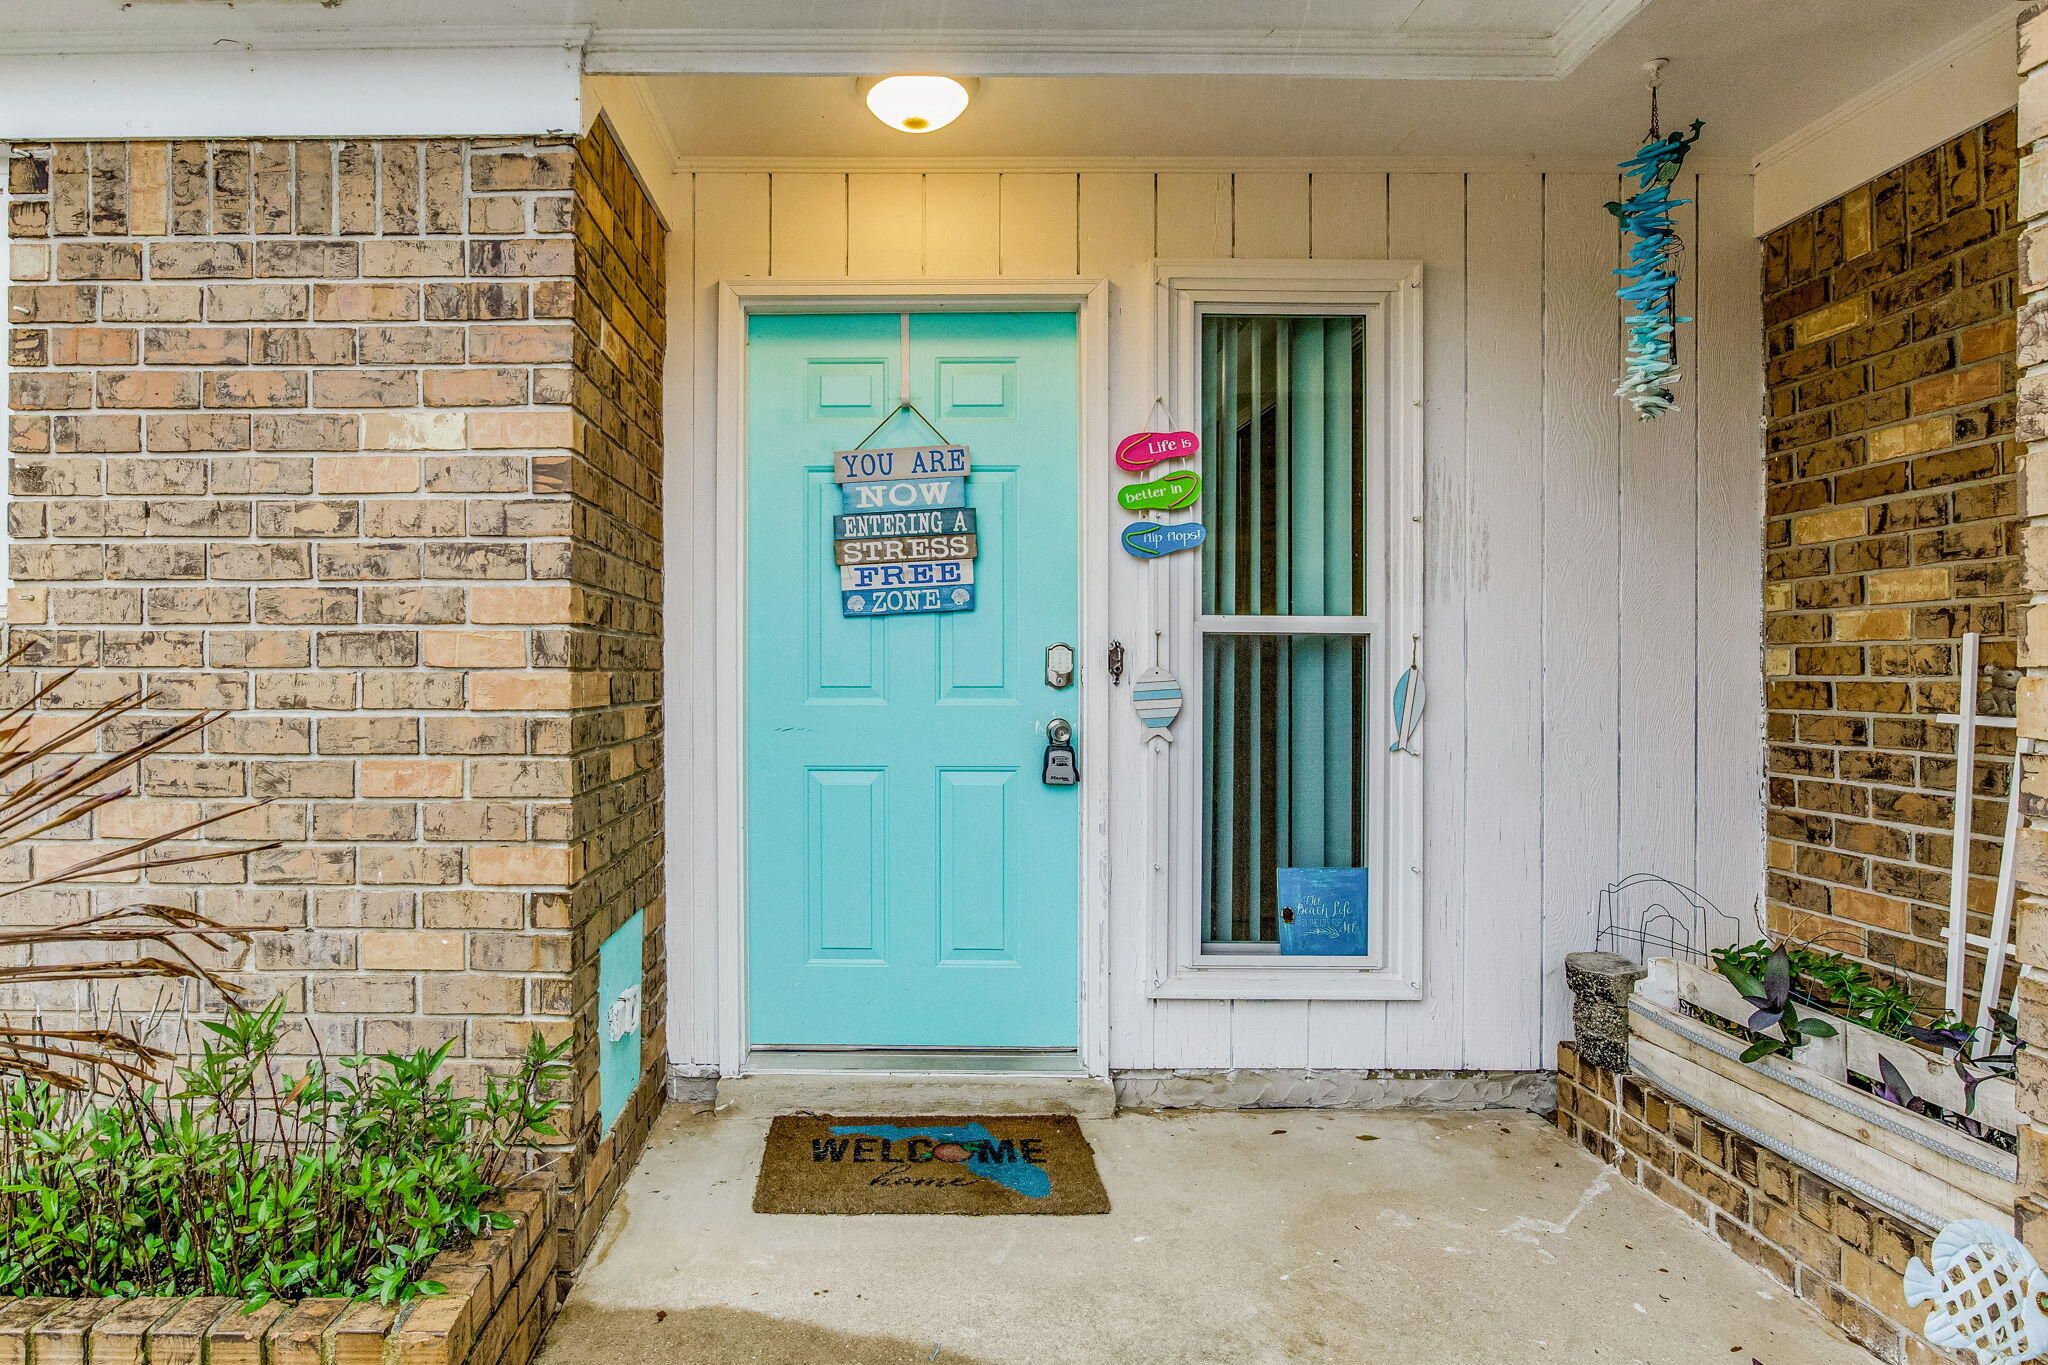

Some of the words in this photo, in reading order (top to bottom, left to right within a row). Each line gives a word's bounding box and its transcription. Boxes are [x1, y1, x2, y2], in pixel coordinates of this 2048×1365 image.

[1148, 439, 1177, 455] Life
[1180, 438, 1192, 448] is
[842, 452, 894, 478] YOU
[911, 449, 965, 474] ARE
[855, 481, 951, 508] NOW
[1125, 486, 1167, 503] better
[1170, 484, 1183, 494] in
[842, 511, 943, 538] ENTERING
[953, 511, 968, 532] A
[843, 535, 969, 563] STRESS
[1143, 532, 1163, 548] flip
[1167, 529, 1201, 547] flops!
[854, 562, 961, 587] FREE
[871, 588, 941, 613] ZONE
[1296, 903, 1328, 918] Beach
[1331, 900, 1354, 919] Life
[811, 1138, 1048, 1164] WELCOME
[868, 1164, 979, 1187] home
